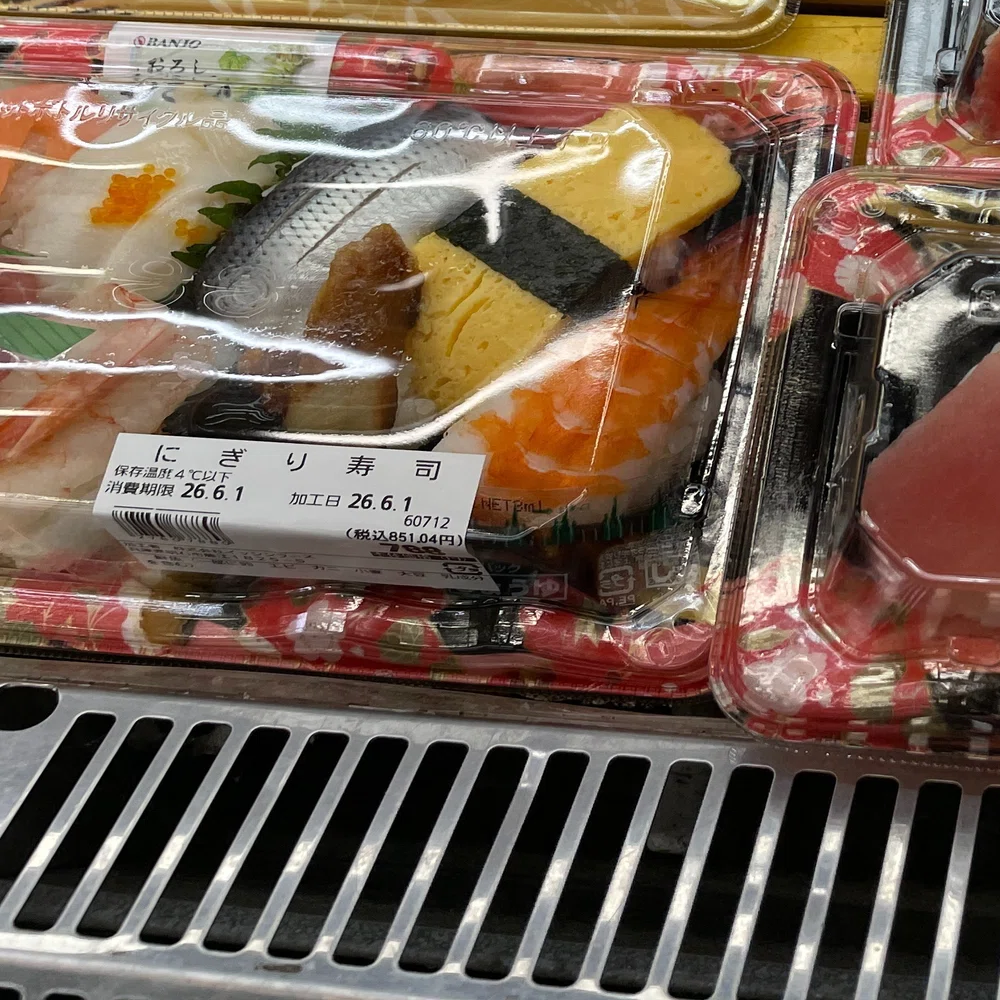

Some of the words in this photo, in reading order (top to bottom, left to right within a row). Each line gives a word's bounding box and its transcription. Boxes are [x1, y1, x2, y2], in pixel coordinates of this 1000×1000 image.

[154, 445, 442, 480] にぎり寿司
[104, 481, 175, 498] 消費期限
[180, 483, 244, 501] 26.6.1
[289, 492, 340, 507] 加工日
[347, 493, 412, 511] 26.6.1
[403, 515, 451, 529] 60712
